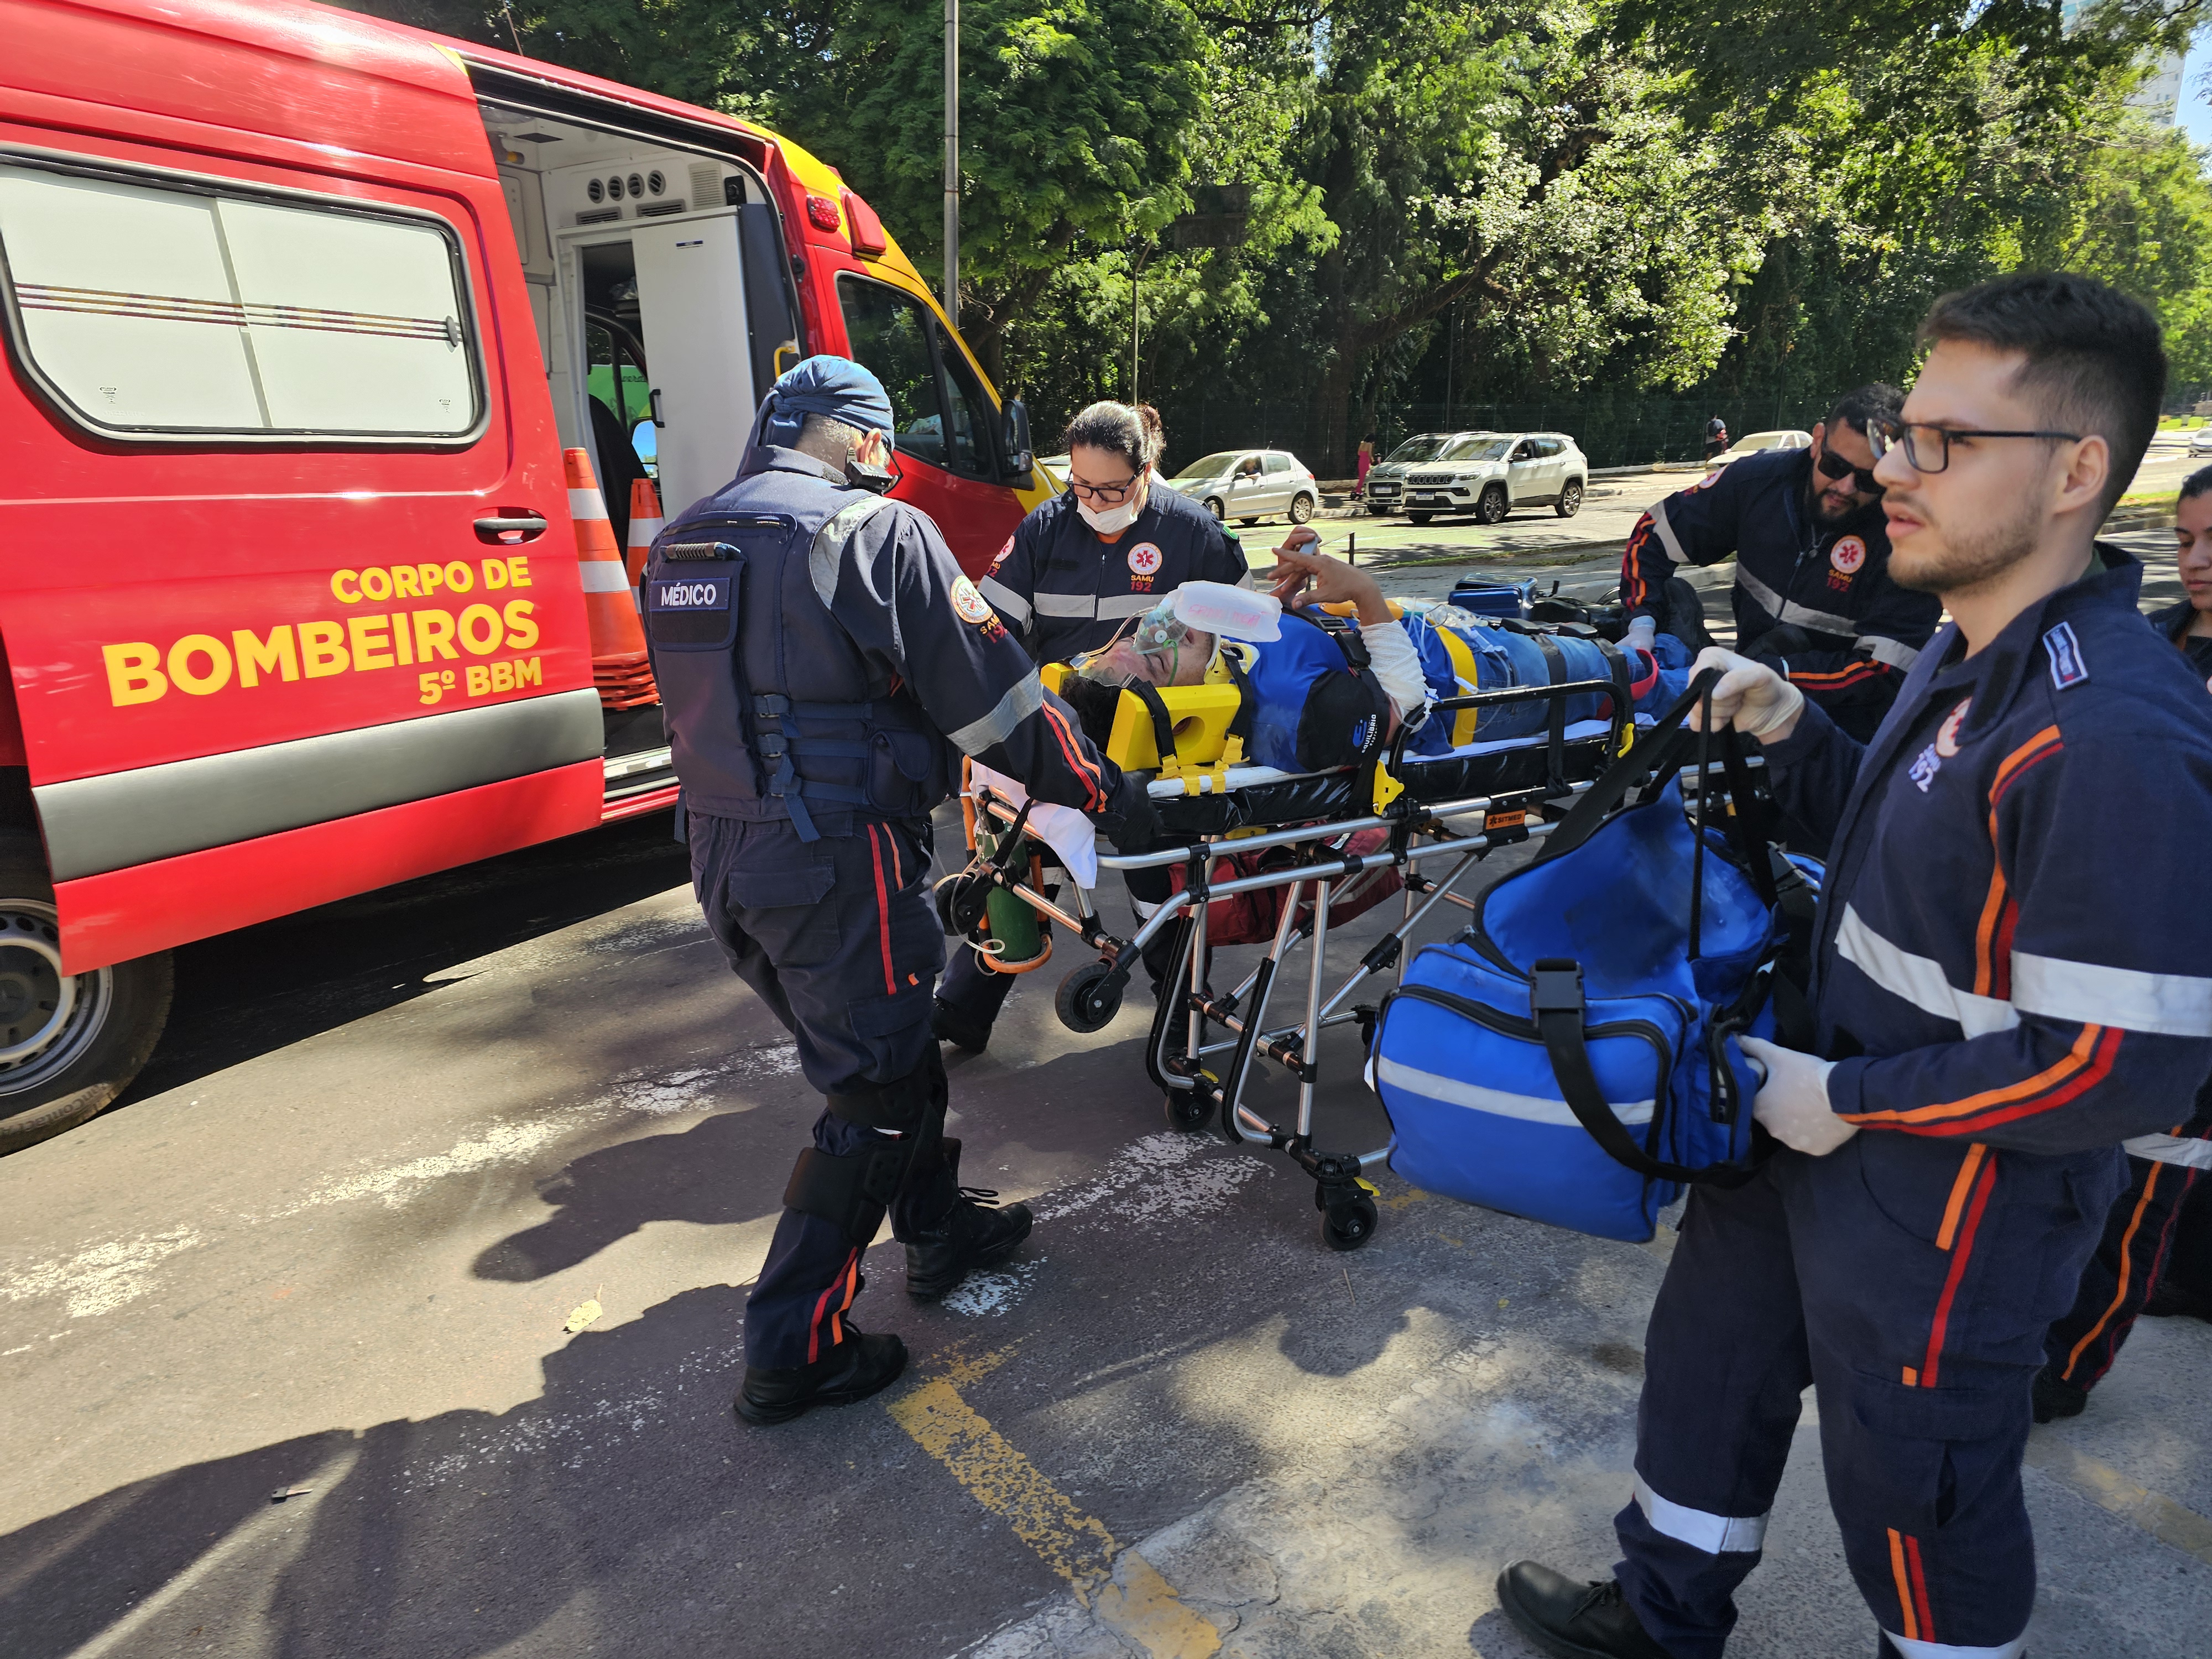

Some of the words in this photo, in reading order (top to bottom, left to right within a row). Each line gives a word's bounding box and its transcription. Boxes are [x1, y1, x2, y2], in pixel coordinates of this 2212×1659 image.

[331, 561, 474, 603] CORPO
[481, 556, 533, 589] DE
[1130, 581, 1152, 592] 192
[1827, 576, 1850, 592] 192
[1828, 569, 1853, 582] SAMU
[661, 582, 717, 606] MÉDICO
[980, 613, 1000, 635] SAM
[102, 599, 539, 707] BOMBEIROS
[419, 670, 456, 705] 5º
[466, 656, 542, 697] BBM
[1908, 752, 1934, 793] 192
[1498, 813, 1522, 823] SITMED
